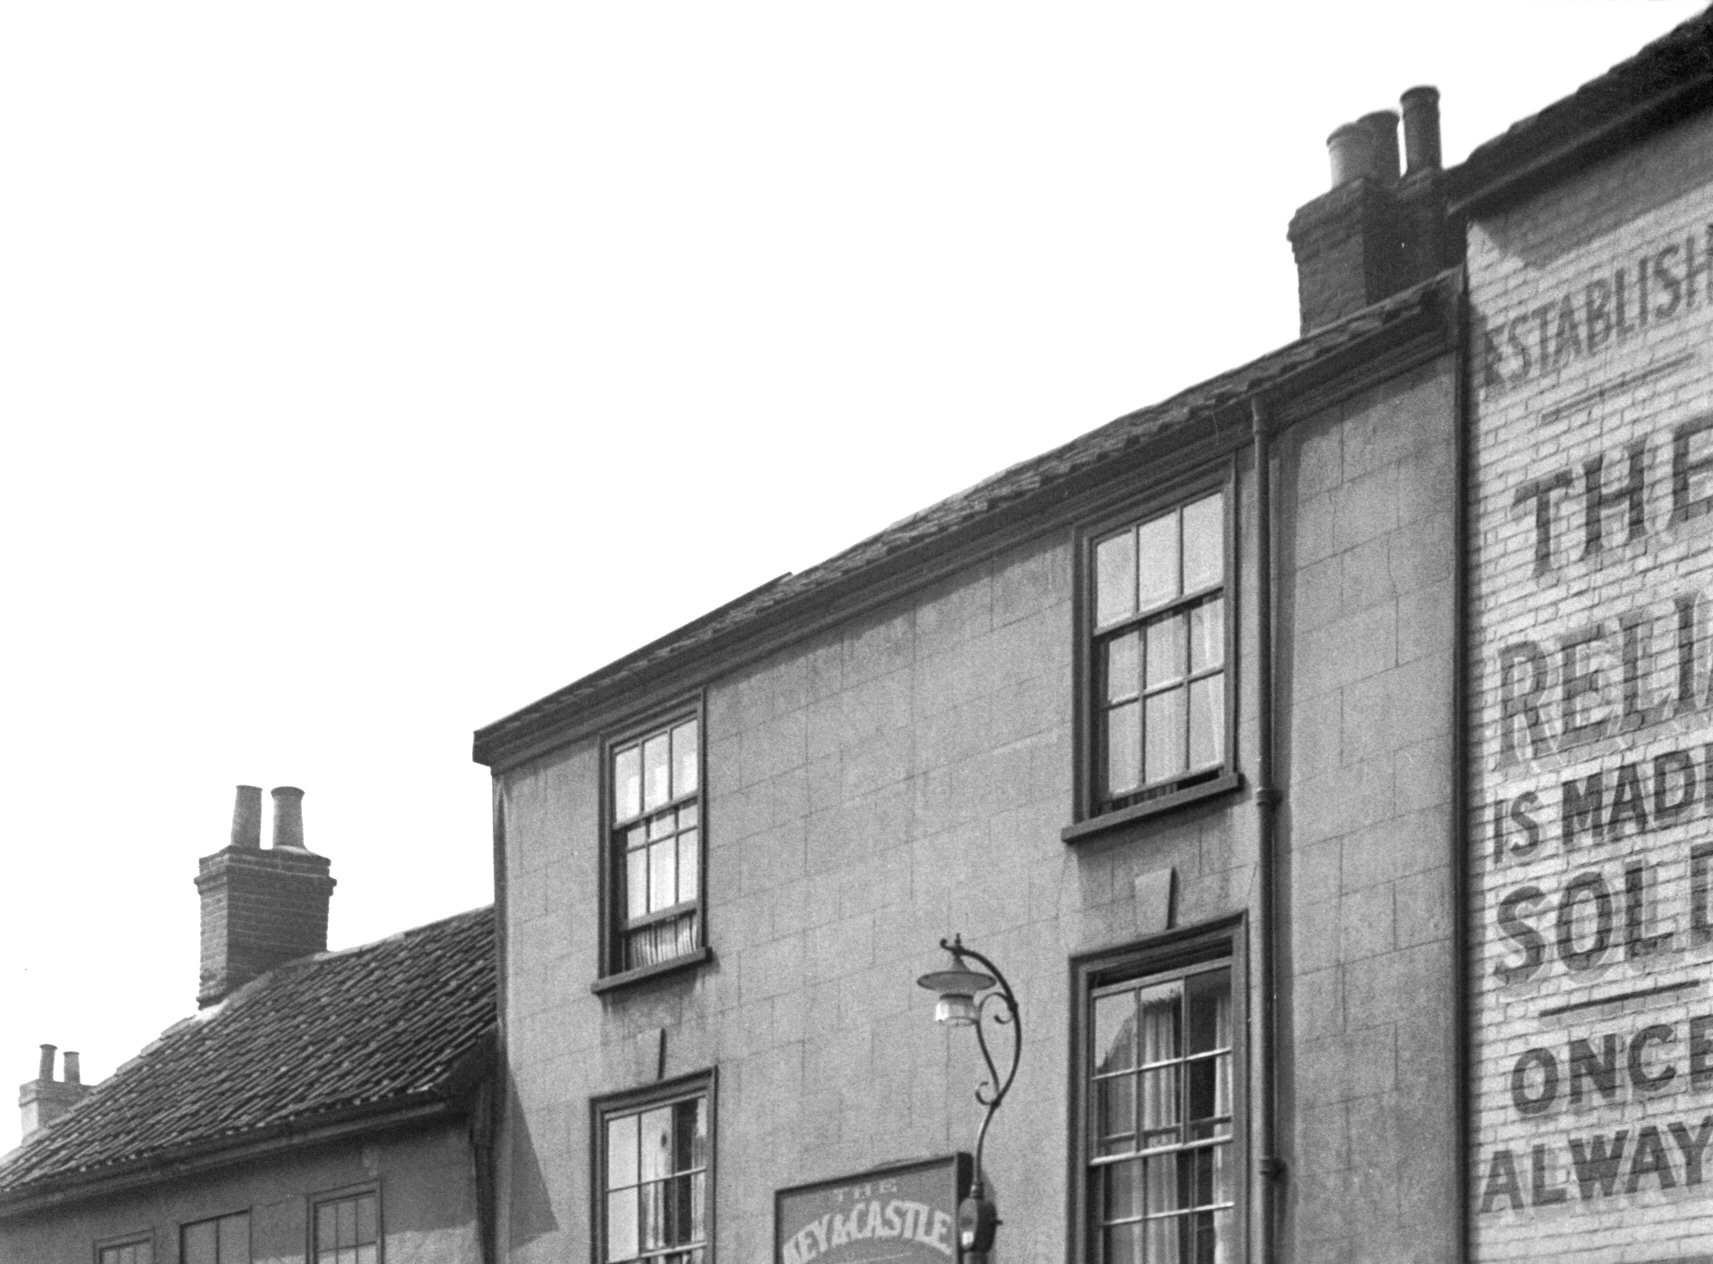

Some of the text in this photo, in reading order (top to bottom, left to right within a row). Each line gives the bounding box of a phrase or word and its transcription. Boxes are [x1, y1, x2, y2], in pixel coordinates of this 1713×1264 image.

[1500, 590, 1713, 768] RELI
[1494, 743, 1713, 864] IS MAD
[832, 1178, 897, 1201] THE
[850, 1199, 951, 1256] CASTLE
